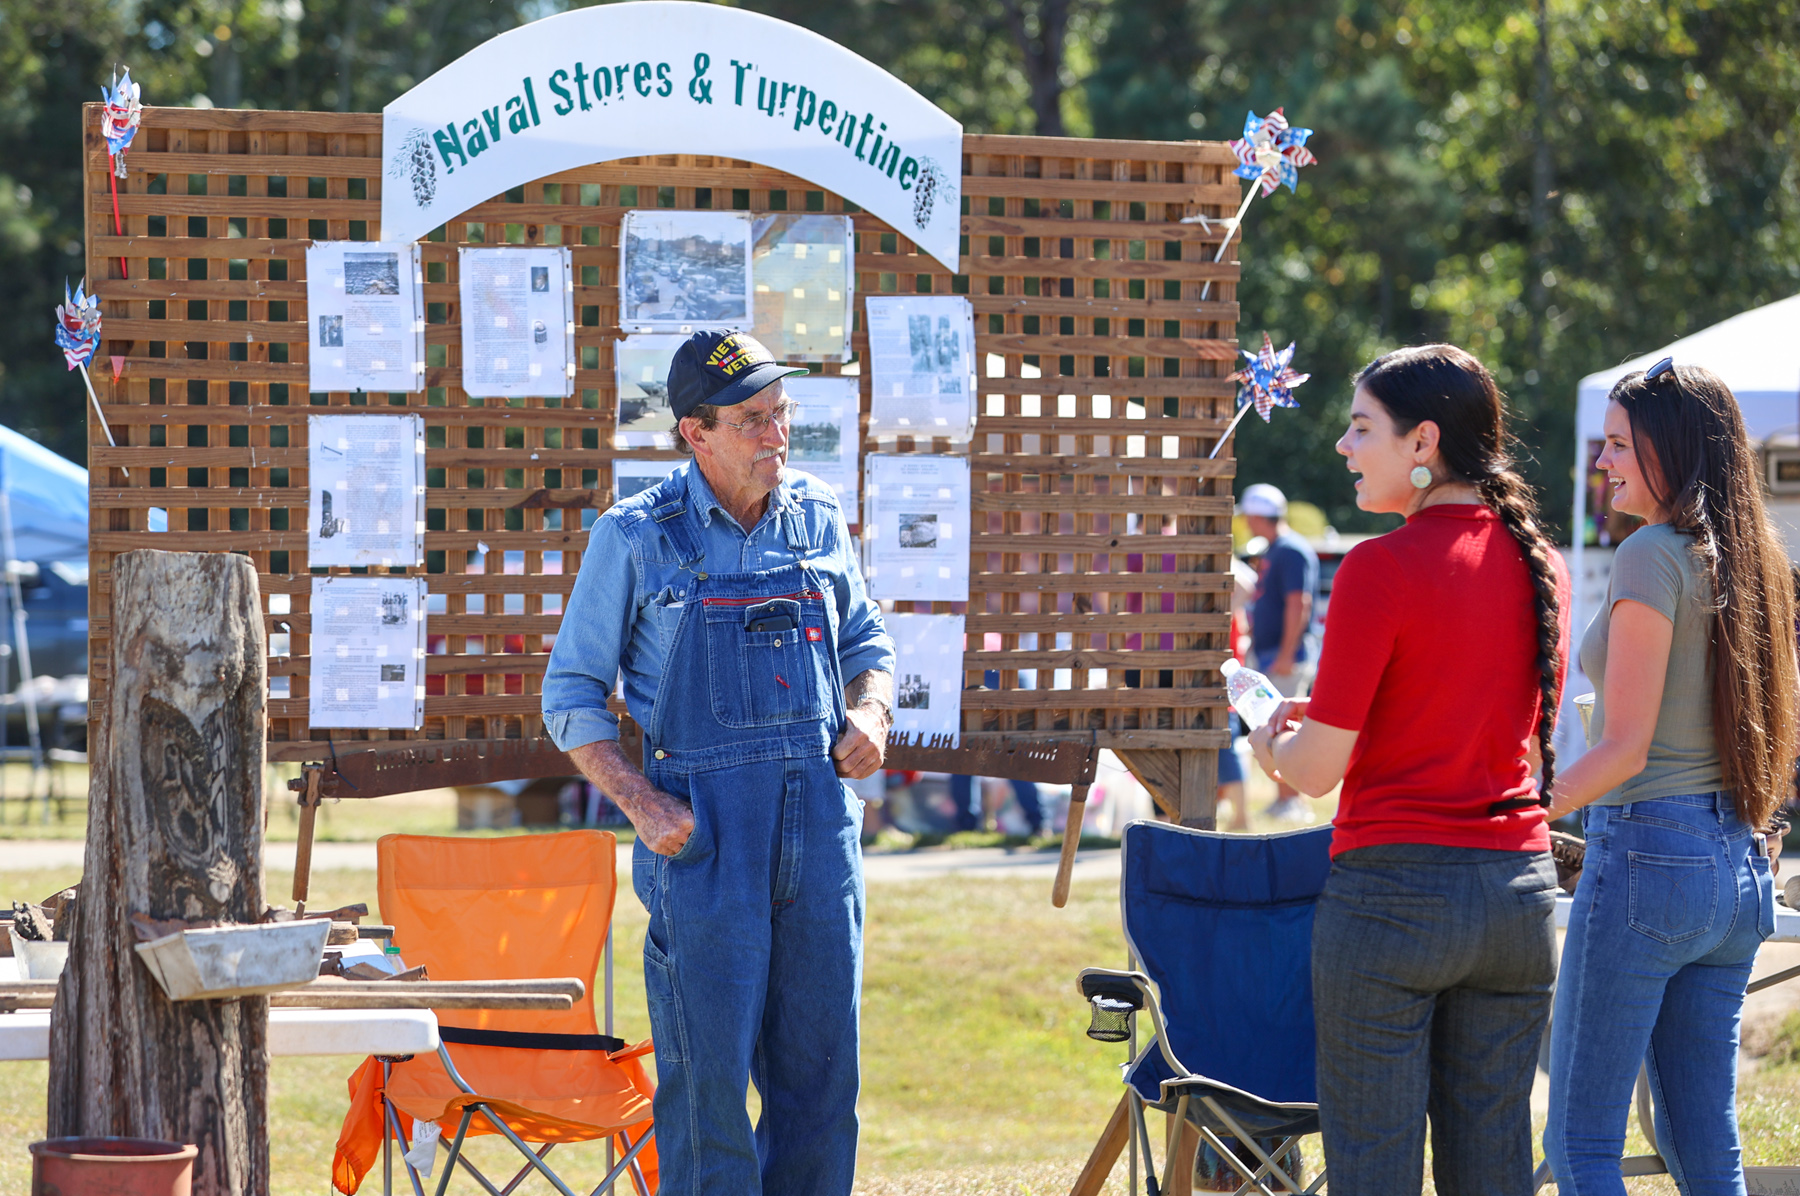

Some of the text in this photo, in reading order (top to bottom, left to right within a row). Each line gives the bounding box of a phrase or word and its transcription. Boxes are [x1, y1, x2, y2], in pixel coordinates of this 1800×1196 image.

[432, 52, 920, 191] Naval Stores & Turpentine
[706, 335, 744, 366] VIET
